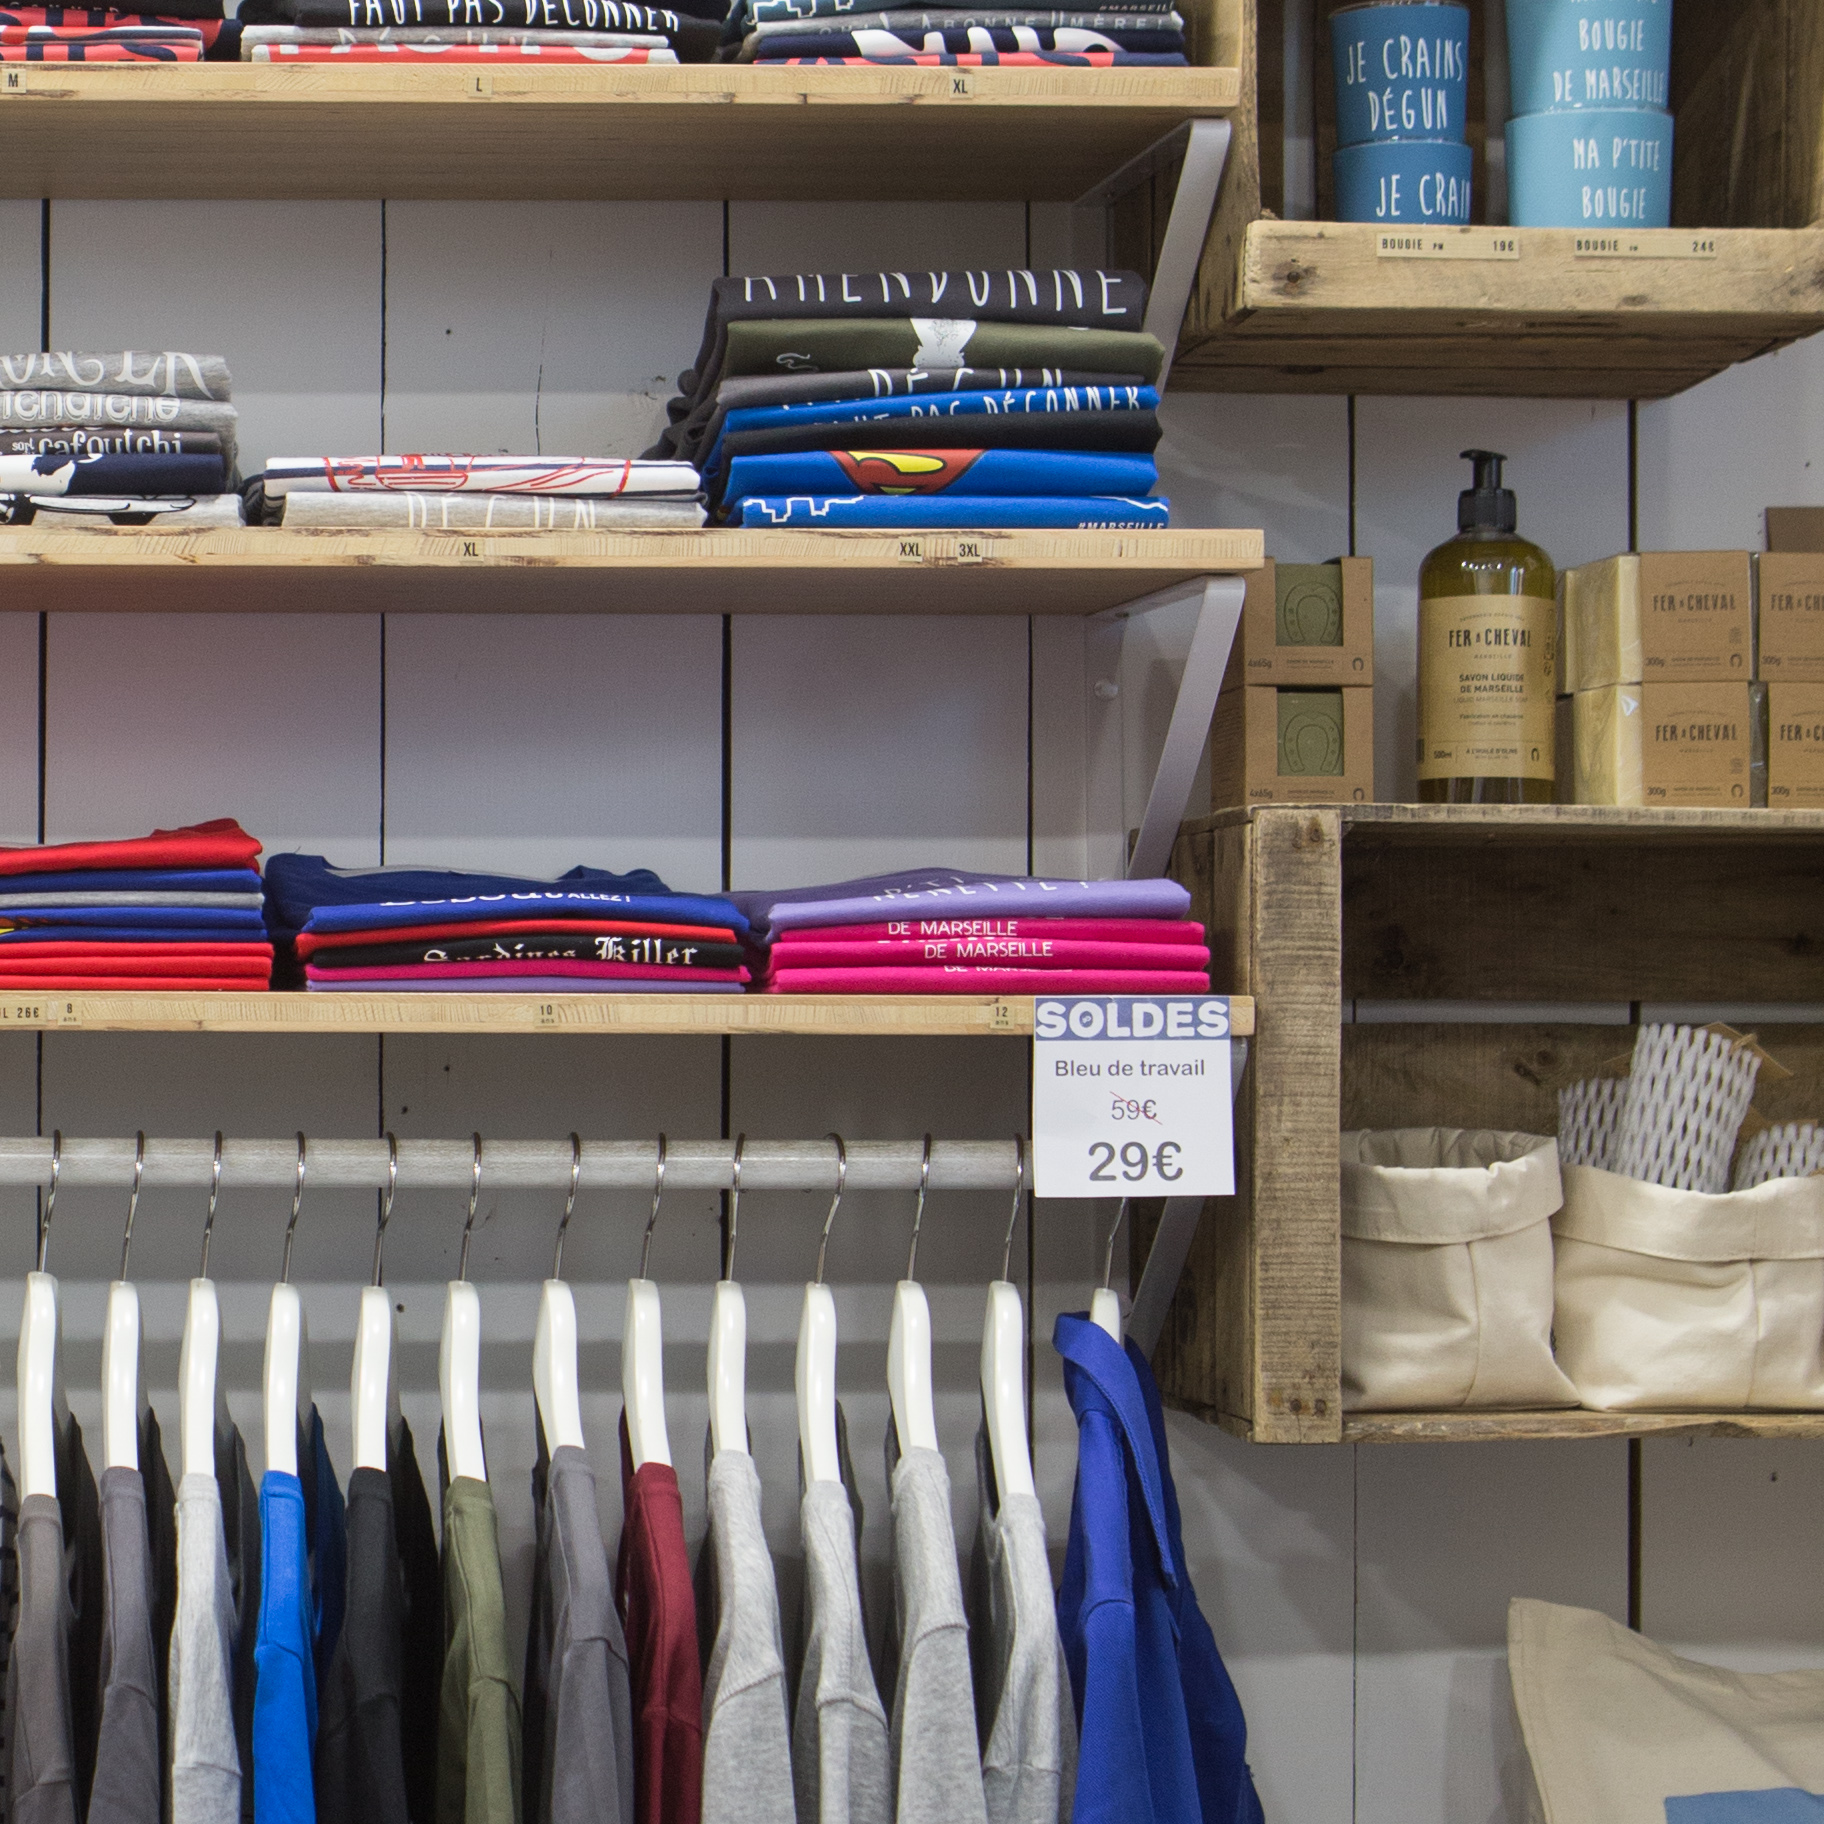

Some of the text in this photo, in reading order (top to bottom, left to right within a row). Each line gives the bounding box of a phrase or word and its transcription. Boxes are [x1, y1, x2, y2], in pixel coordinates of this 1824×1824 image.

[1578, 17, 1645, 52] BOUGIE
[1346, 35, 1464, 86] JE CRAINS
[8, 72, 19, 88] M
[475, 77, 483, 93] L
[952, 78, 969, 94] XL
[1552, 68, 1666, 105] DE MARSEILLE
[1368, 87, 1449, 132] DÉGUN
[1572, 136, 1661, 173] MA P'TITE
[1376, 173, 1401, 219] JE
[1581, 186, 1647, 220] BOUGIE
[1381, 237, 1424, 251] BOUGIE
[1576, 238, 1619, 252] BOUGIE
[462, 542, 479, 558] XL
[899, 542, 922, 558] XXL
[958, 542, 981, 558] 3XL
[1653, 593, 1737, 612] FER CHEVAL
[1771, 594, 1794, 612] FER
[1449, 628, 1531, 648] FER CHEVAL
[1459, 673, 1489, 683] SAVON
[1474, 684, 1524, 695] MARSEILLE
[1655, 723, 1738, 742] FER CHEVAL
[1780, 724, 1802, 742] FER
[888, 920, 1019, 937] DE MARSEILLE
[594, 935, 699, 966] Killer
[924, 941, 1053, 960] DE MARSEILLE
[17, 1005, 40, 1019] 26€
[66, 1002, 73, 1014] 8
[540, 1004, 553, 1016] 10
[995, 1006, 1008, 1017] 12
[1034, 1000, 1231, 1039] SOLDES
[1055, 1058, 1206, 1077] Bleu de travail
[1110, 1098, 1158, 1122] 59€
[1087, 1139, 1185, 1184] 29€
